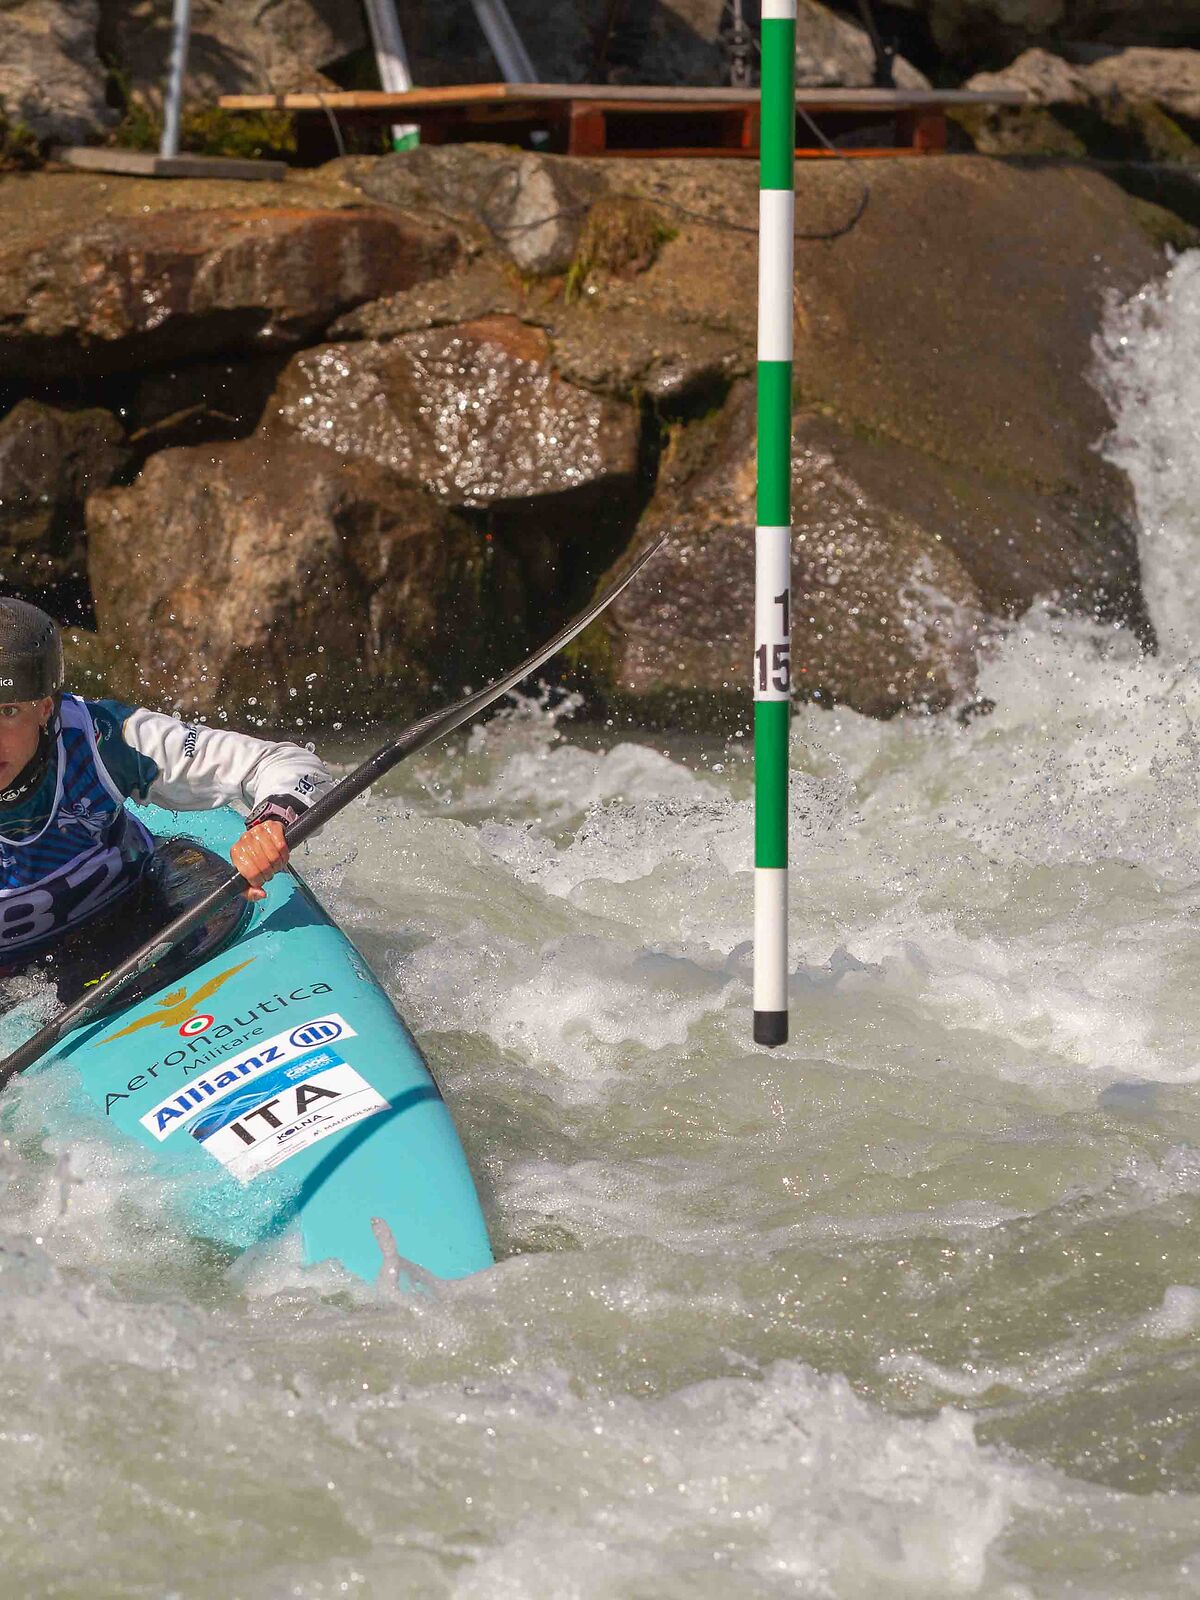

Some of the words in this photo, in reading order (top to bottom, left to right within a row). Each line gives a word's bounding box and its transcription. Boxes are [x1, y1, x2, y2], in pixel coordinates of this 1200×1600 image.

[755, 643, 790, 692] 15
[104, 982, 333, 1116] Aeronautica
[183, 1026, 265, 1076] Militare
[153, 1045, 286, 1133] Allianz
[230, 1083, 343, 1146] ITA
[276, 1113, 323, 1141] KOLNA
